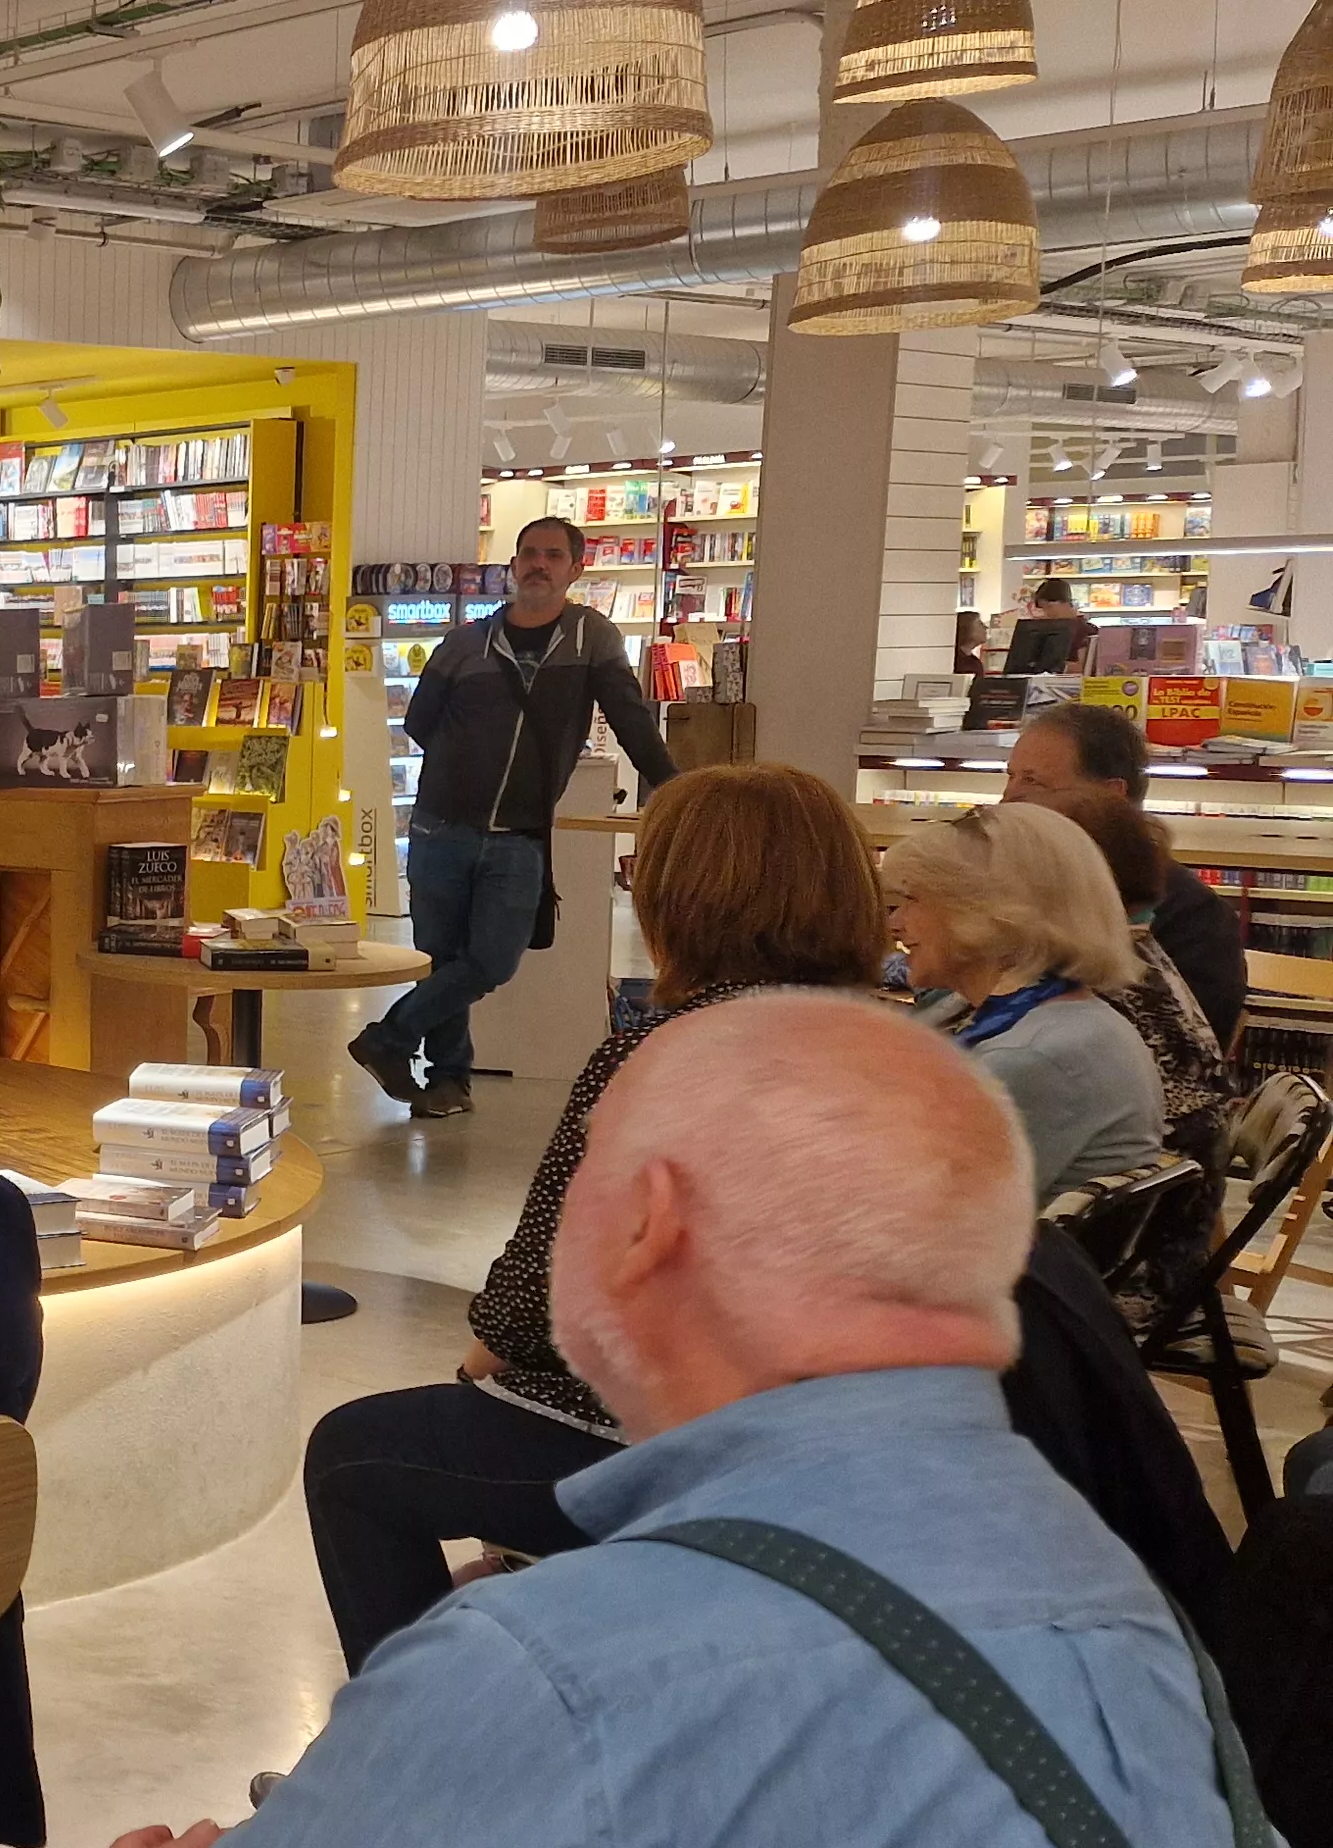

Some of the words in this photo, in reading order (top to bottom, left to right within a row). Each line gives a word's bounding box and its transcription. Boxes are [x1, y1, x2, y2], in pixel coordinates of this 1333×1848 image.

[388, 599, 451, 620] smartbox
[1161, 707, 1200, 719] LPAC
[147, 850, 170, 862] LUIS
[138, 861, 178, 874] ZUECO
